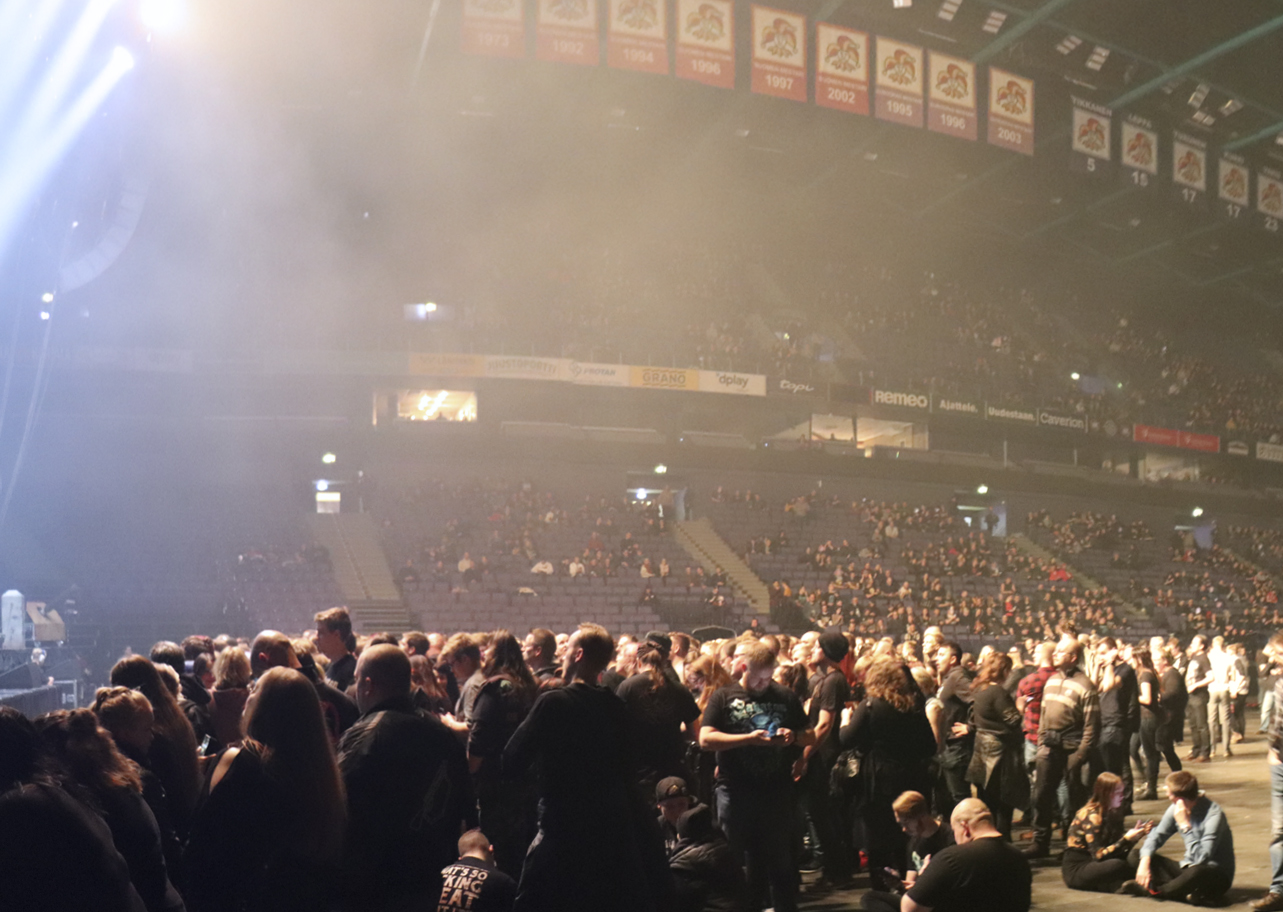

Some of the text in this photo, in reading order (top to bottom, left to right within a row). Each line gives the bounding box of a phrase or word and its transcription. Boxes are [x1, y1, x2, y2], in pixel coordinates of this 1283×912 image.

[553, 39, 584, 55] 1992
[623, 48, 654, 63] 1994
[692, 59, 721, 75] 1996
[765, 74, 794, 90] 1997
[828, 87, 856, 104] 2002
[887, 100, 913, 117] 1995
[941, 113, 966, 130] 1996
[997, 127, 1022, 144] 2003
[1087, 157, 1095, 172] 5
[1182, 188, 1196, 203] 17
[1227, 204, 1241, 218] 17
[643, 371, 687, 385] GRANO
[719, 373, 749, 389] dplay
[875, 390, 928, 408] Remeo
[1040, 413, 1084, 430] Caverion
[469, 869, 488, 881] SO
[442, 875, 483, 893] KING
